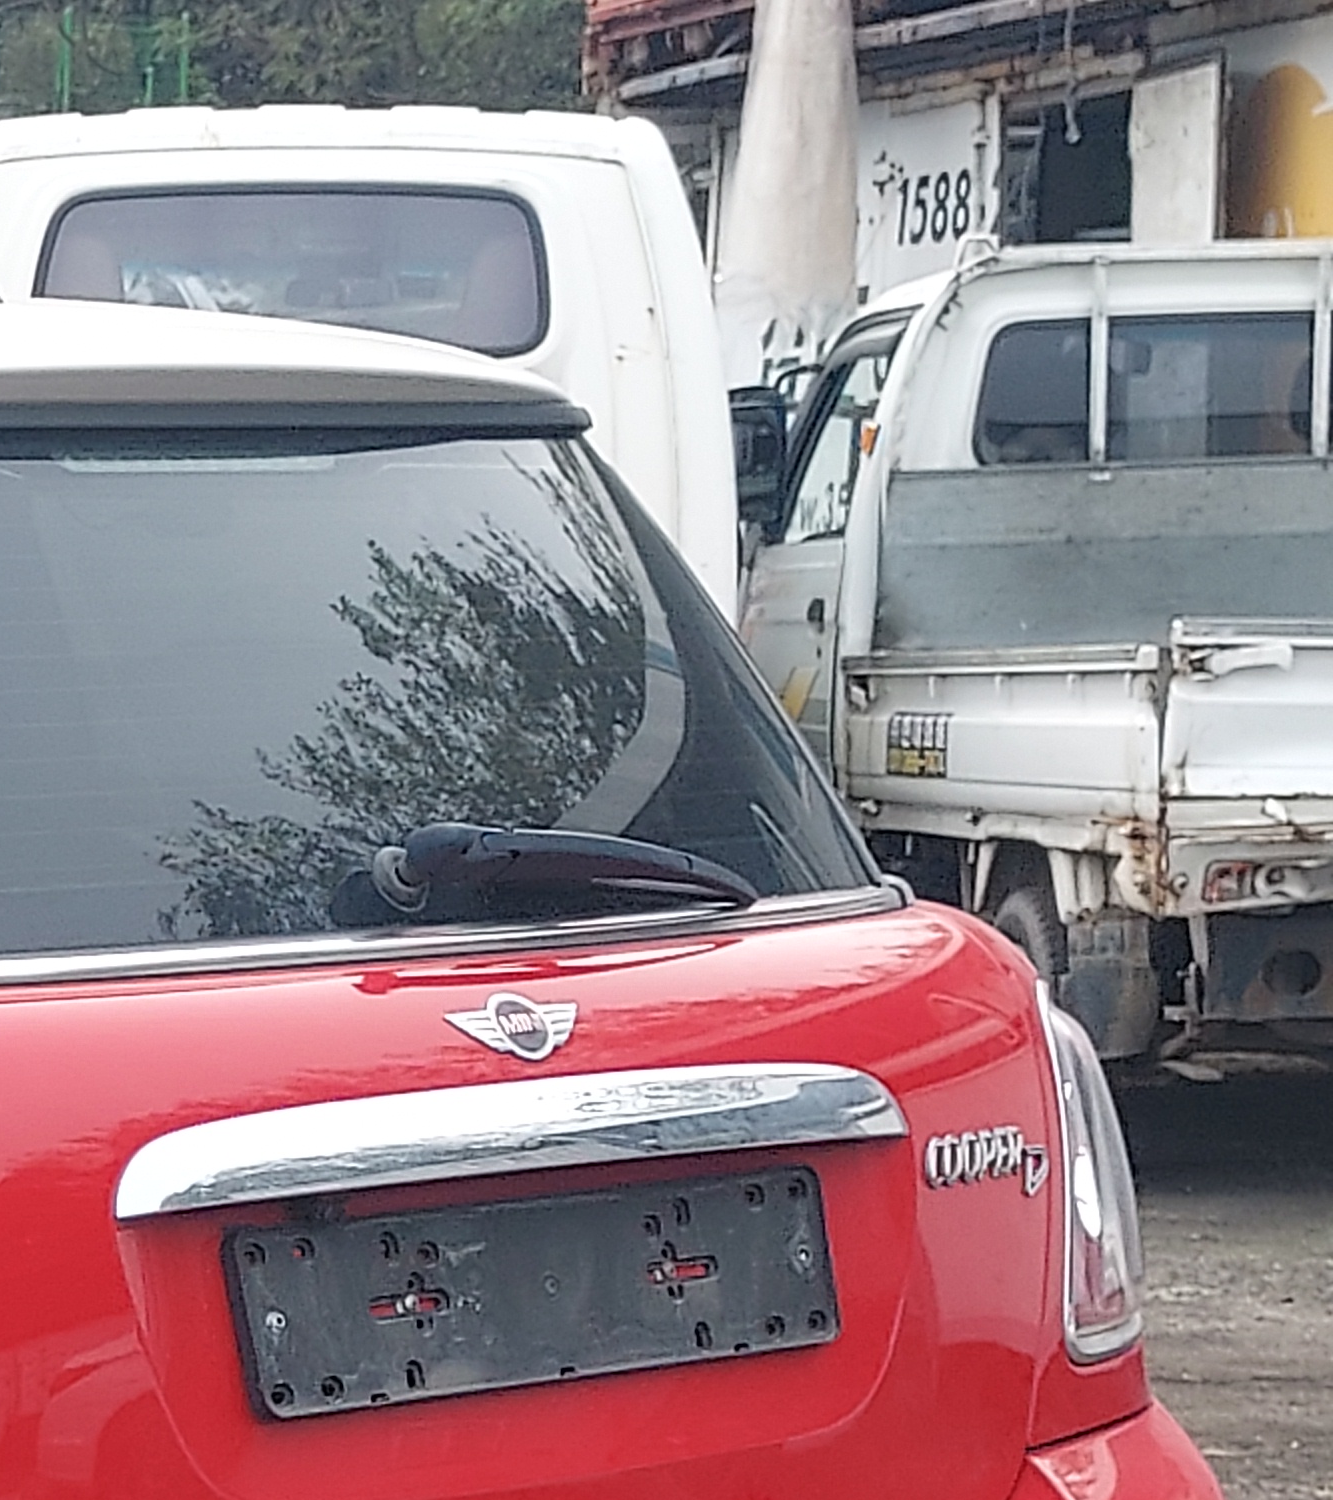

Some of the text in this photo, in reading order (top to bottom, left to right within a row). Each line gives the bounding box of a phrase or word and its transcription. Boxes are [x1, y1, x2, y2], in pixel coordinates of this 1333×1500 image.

[897, 168, 971, 246] 1588
[925, 1125, 1050, 1198] COOPER D
